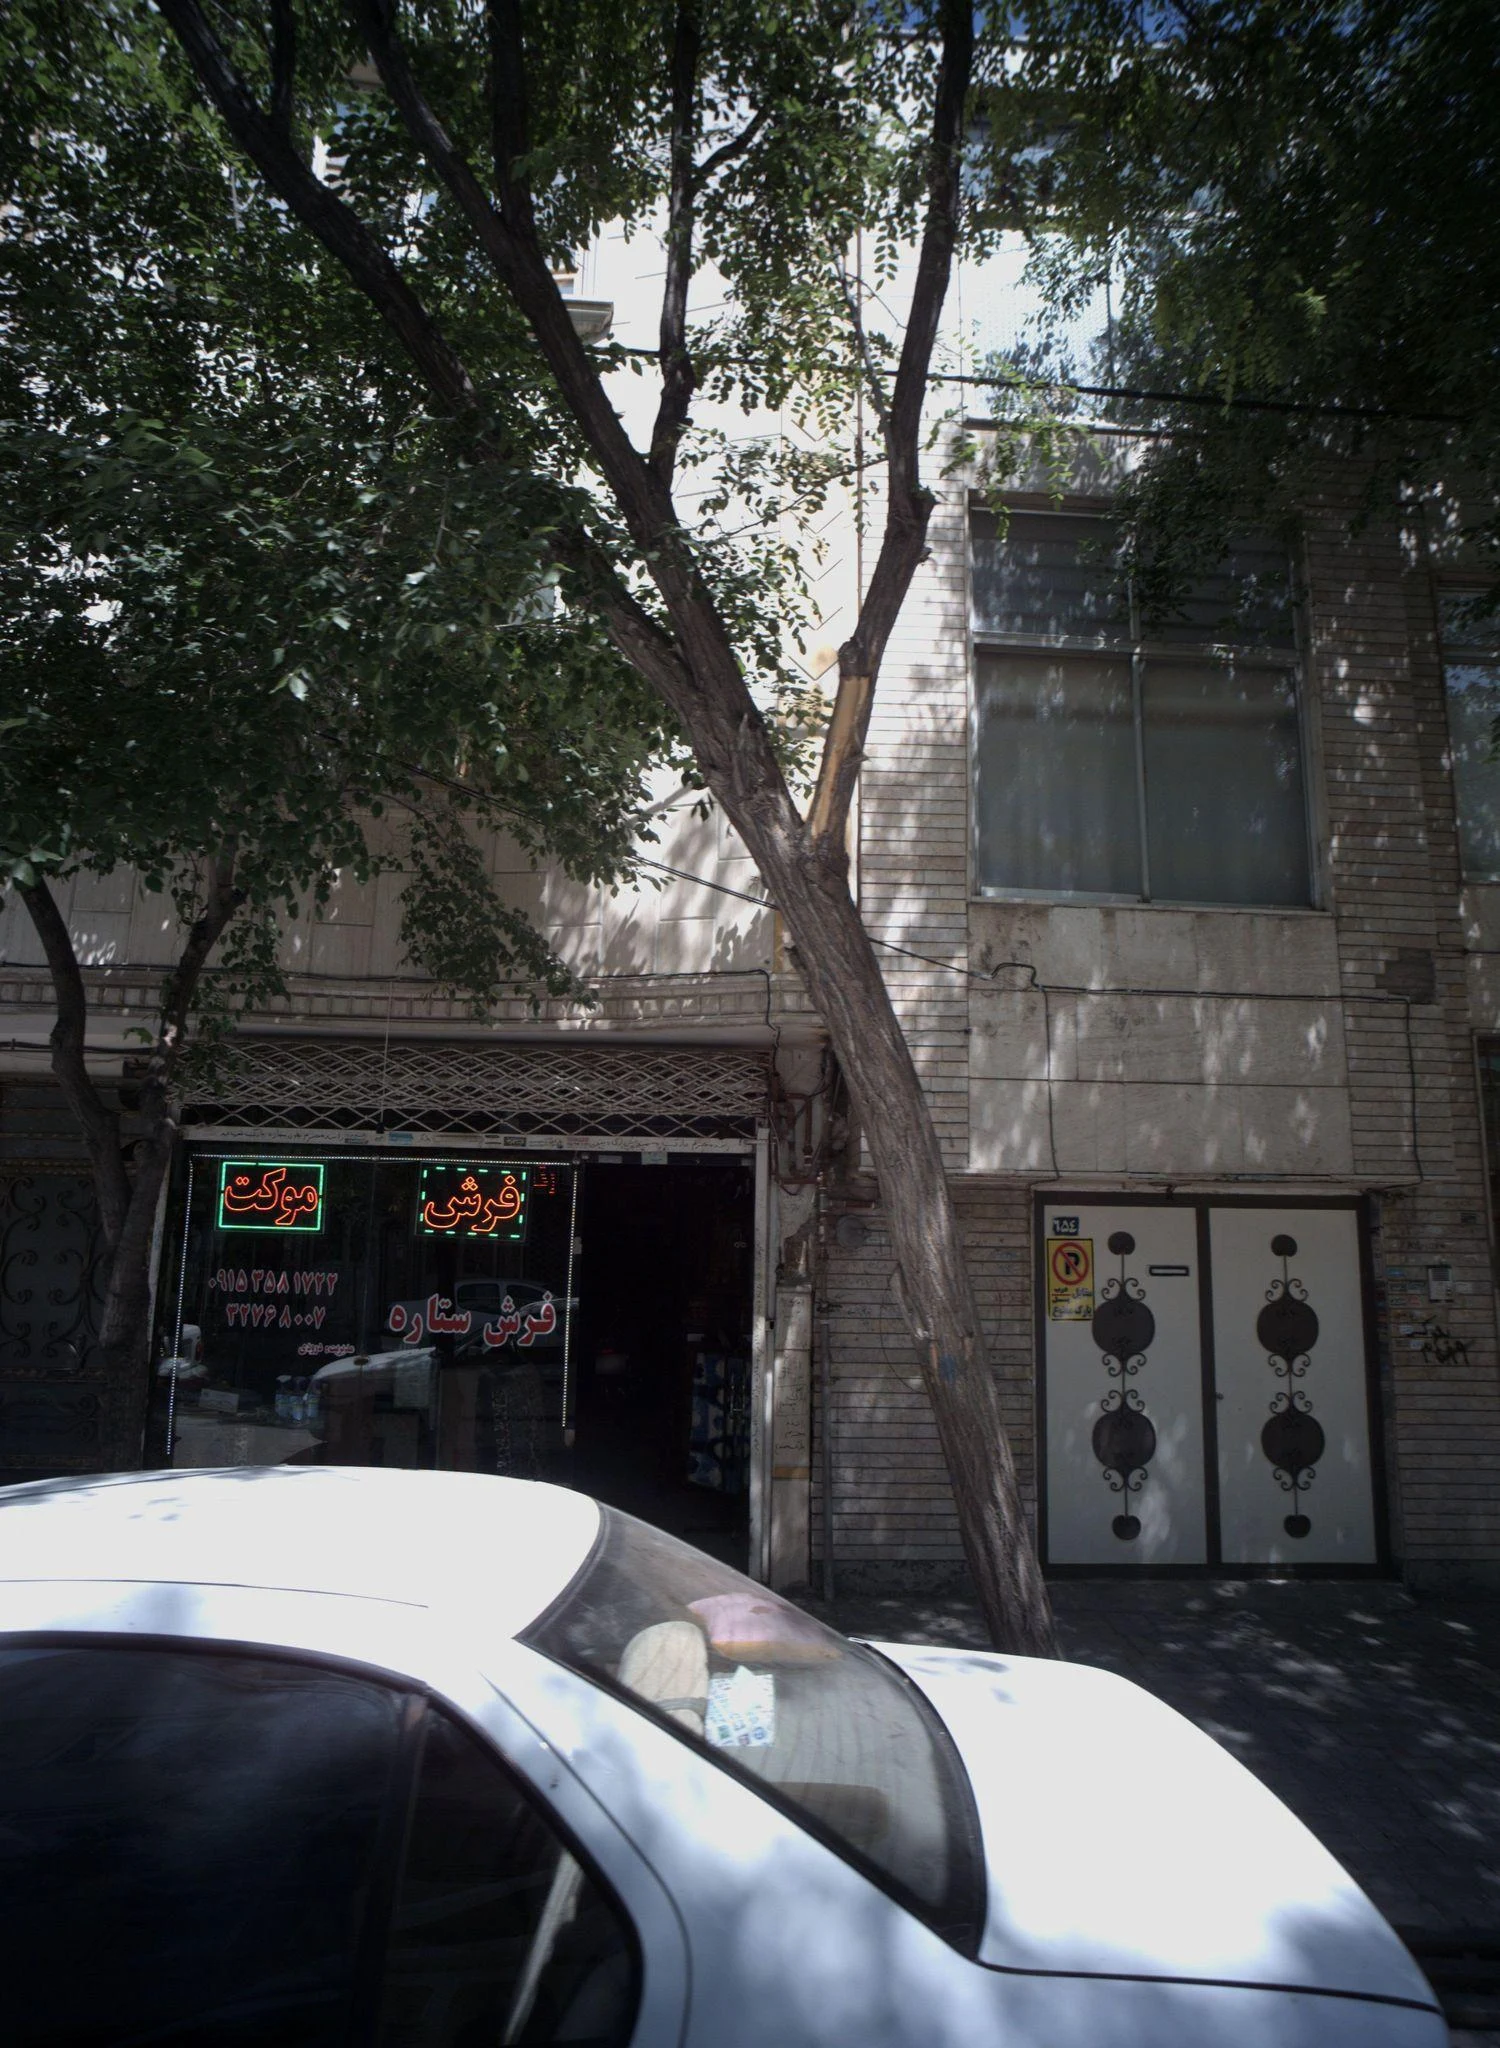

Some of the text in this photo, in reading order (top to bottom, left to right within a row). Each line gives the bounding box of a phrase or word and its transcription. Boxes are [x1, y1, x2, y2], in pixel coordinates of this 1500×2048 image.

[224, 1167, 319, 1226] موکت
[424, 1174, 521, 1232] فرش
[389, 1290, 557, 1347] فرش ستاره
